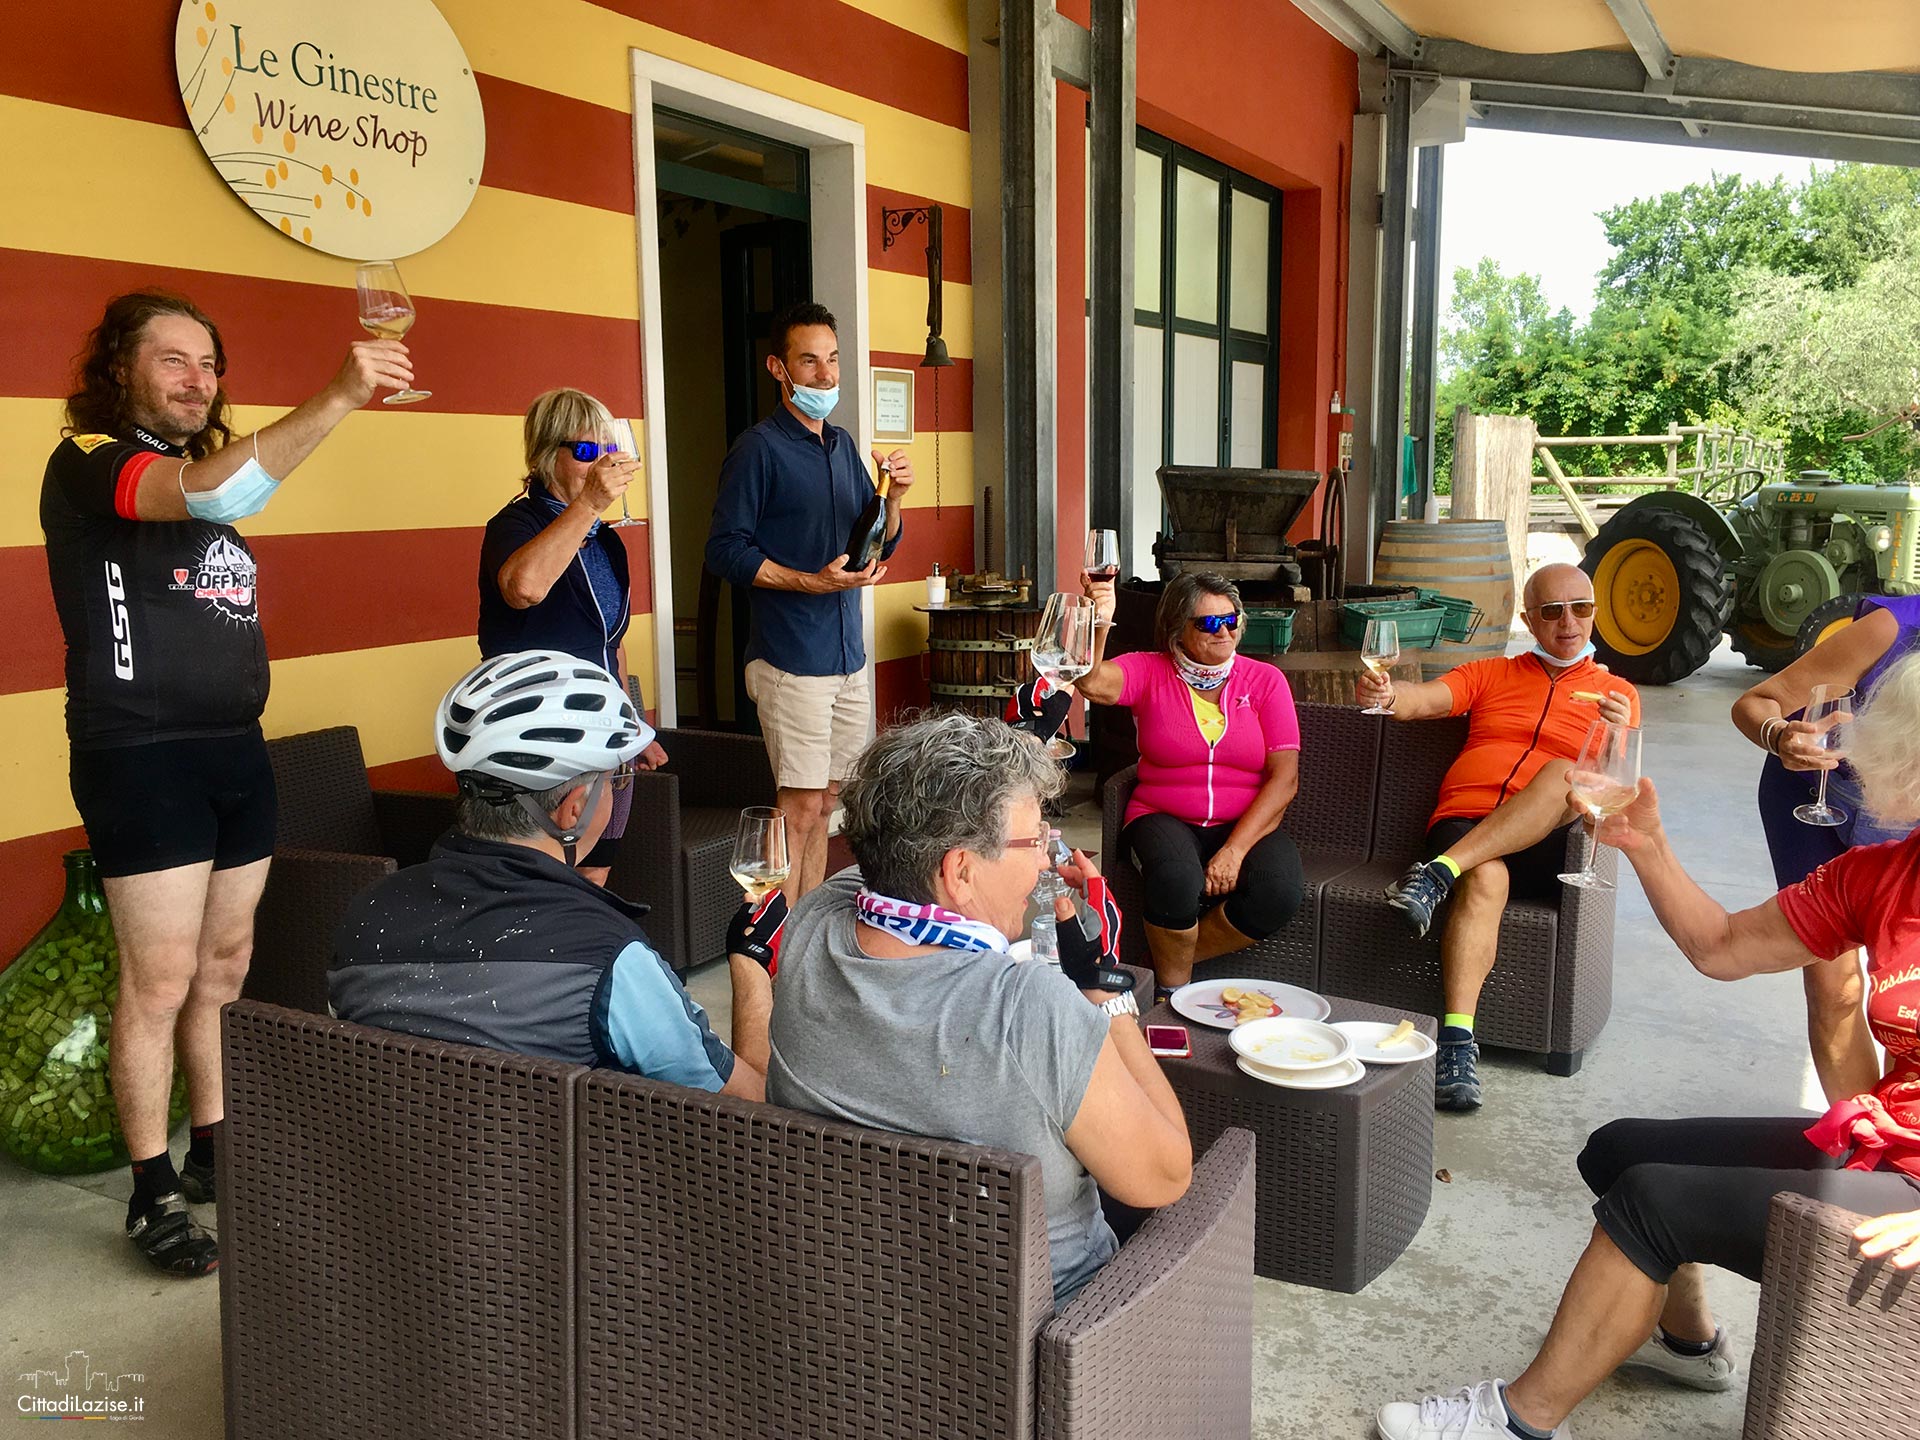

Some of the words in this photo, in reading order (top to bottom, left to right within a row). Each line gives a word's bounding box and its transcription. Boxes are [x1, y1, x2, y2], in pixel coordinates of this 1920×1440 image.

[229, 23, 280, 78] Le
[291, 41, 439, 113] Ginestre
[254, 92, 350, 142] Wine
[352, 113, 428, 168] Shop
